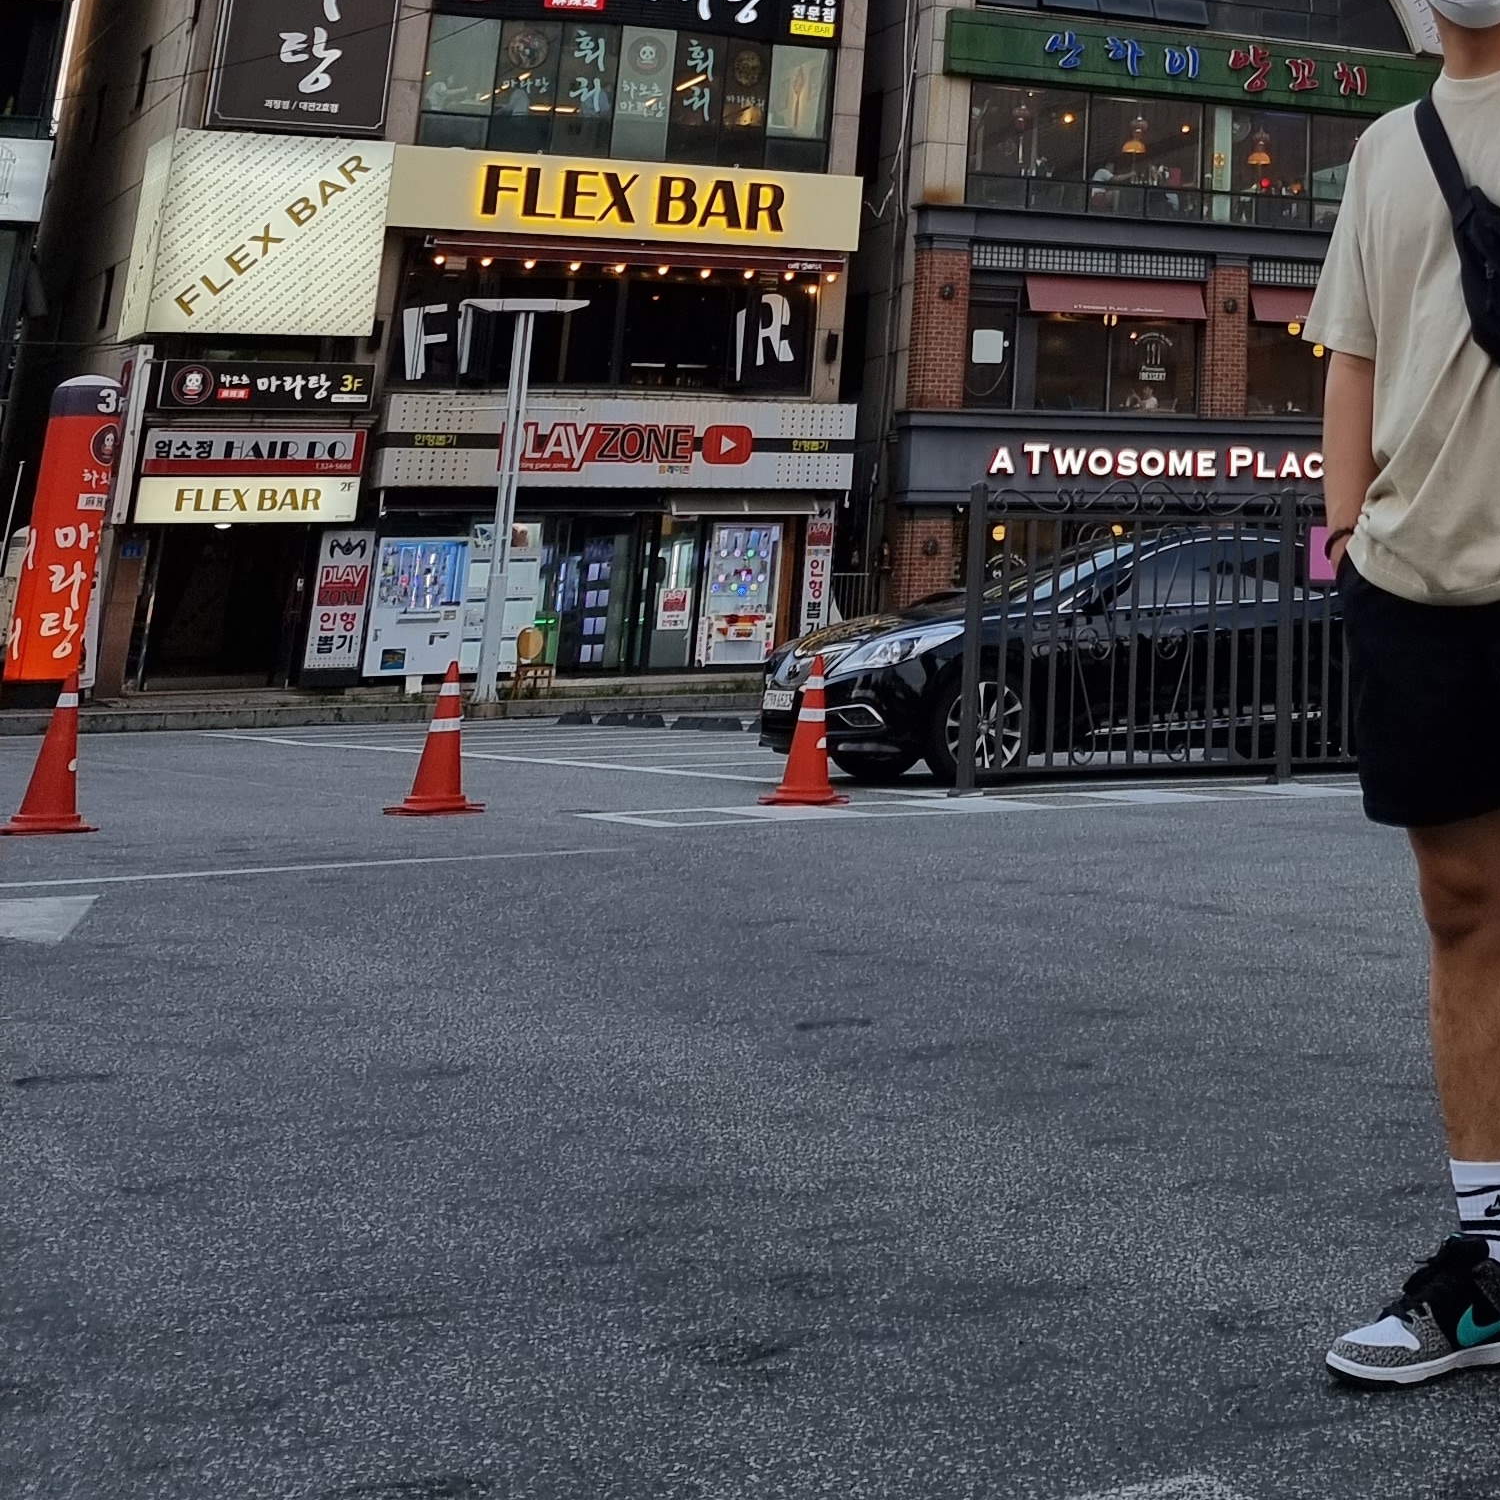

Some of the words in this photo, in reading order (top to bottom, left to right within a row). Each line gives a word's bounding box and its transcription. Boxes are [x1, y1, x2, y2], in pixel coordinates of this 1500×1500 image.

[480, 164, 640, 224] FLEX
[655, 176, 785, 233] BAR
[174, 222, 286, 317] FLEX
[285, 155, 374, 227] BAR
[257, 373, 331, 399] 마라탕
[340, 374, 363, 392] 3F
[155, 439, 213, 458] 엄소정
[224, 440, 299, 459] HAIR
[307, 440, 347, 459] DO
[507, 424, 596, 468] LAY
[597, 426, 692, 461] ZONE
[990, 447, 1015, 474] A
[1023, 442, 1216, 477] TWOSOME
[1229, 446, 1324, 479] PLAC
[340, 482, 355, 492] 2F
[174, 489, 250, 512] FLEX
[257, 489, 322, 512] BAR
[39, 522, 95, 659] 마라탕
[319, 612, 356, 632] 인형
[317, 635, 353, 654] 뽑기
